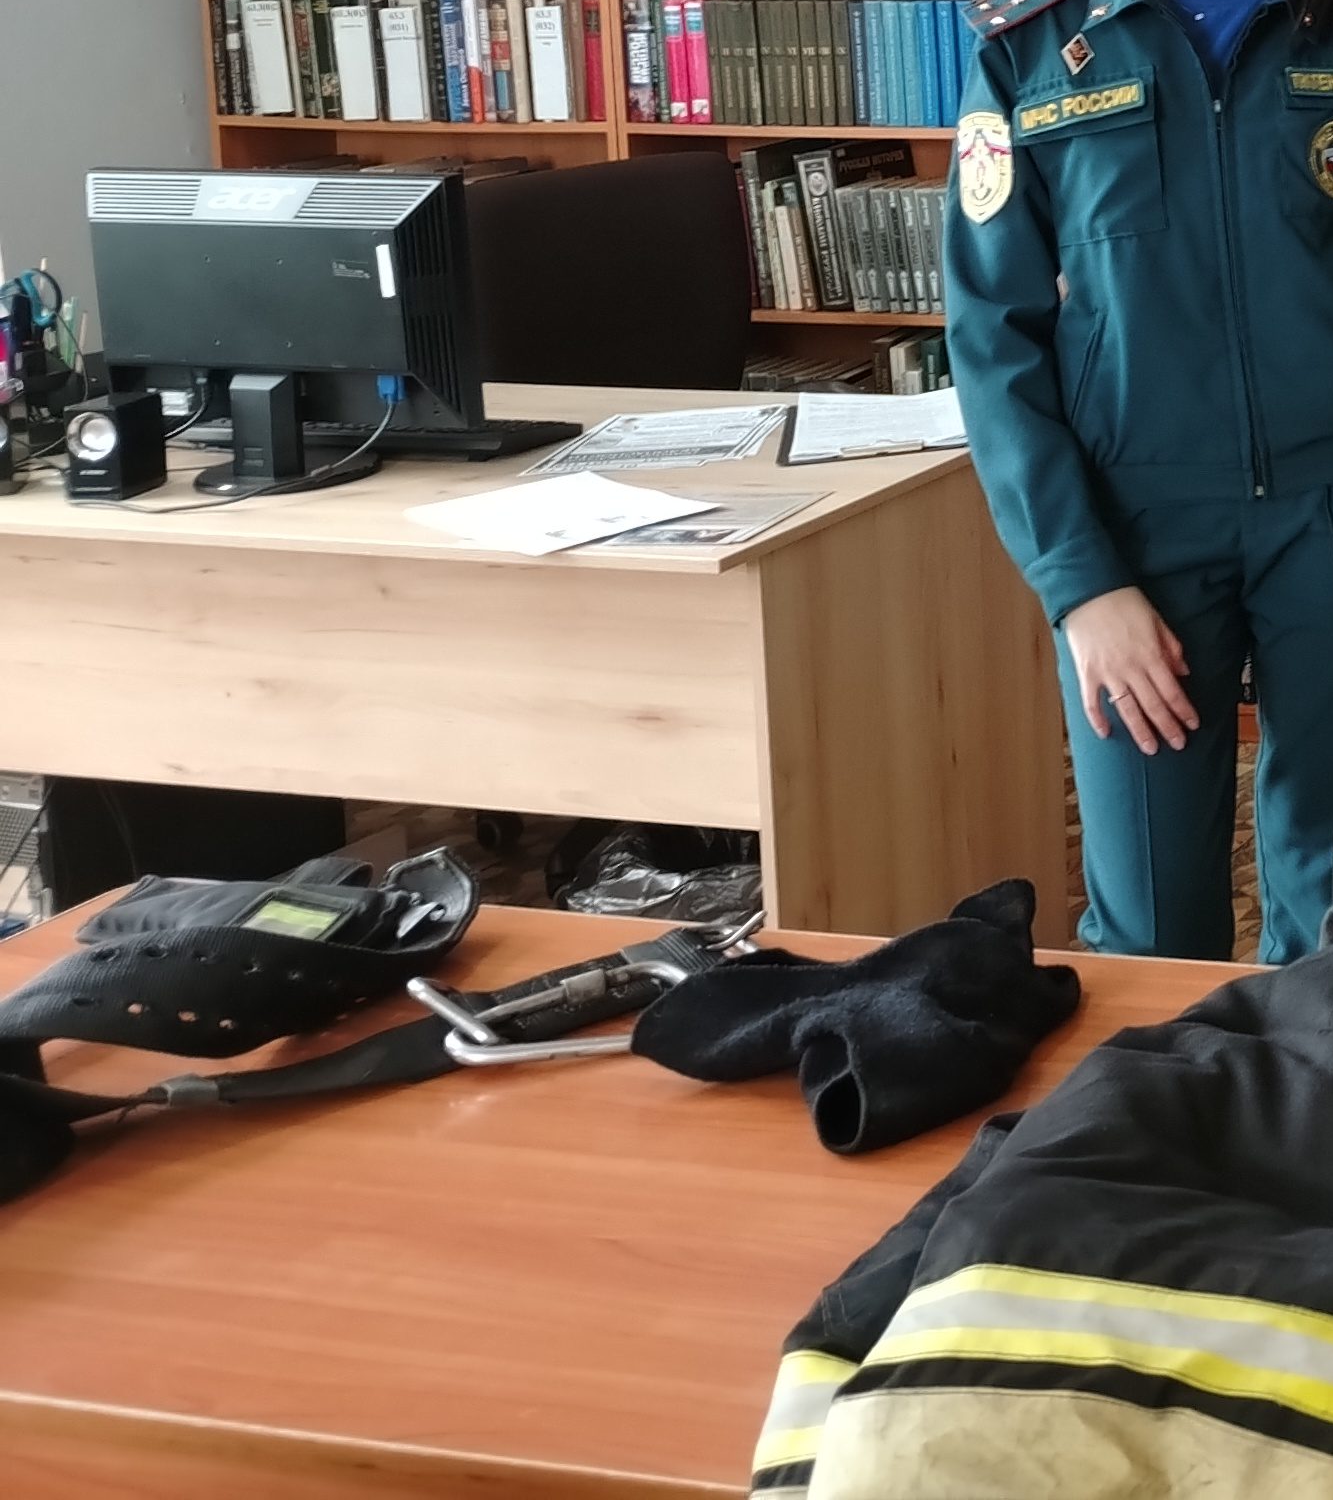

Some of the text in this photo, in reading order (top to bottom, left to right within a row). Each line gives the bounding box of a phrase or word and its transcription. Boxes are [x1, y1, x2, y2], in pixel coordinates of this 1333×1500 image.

[1020, 84, 1139, 130] МЧС РОССИИ
[840, 158, 871, 172] РУССКАЯ
[208, 186, 297, 212] acer
